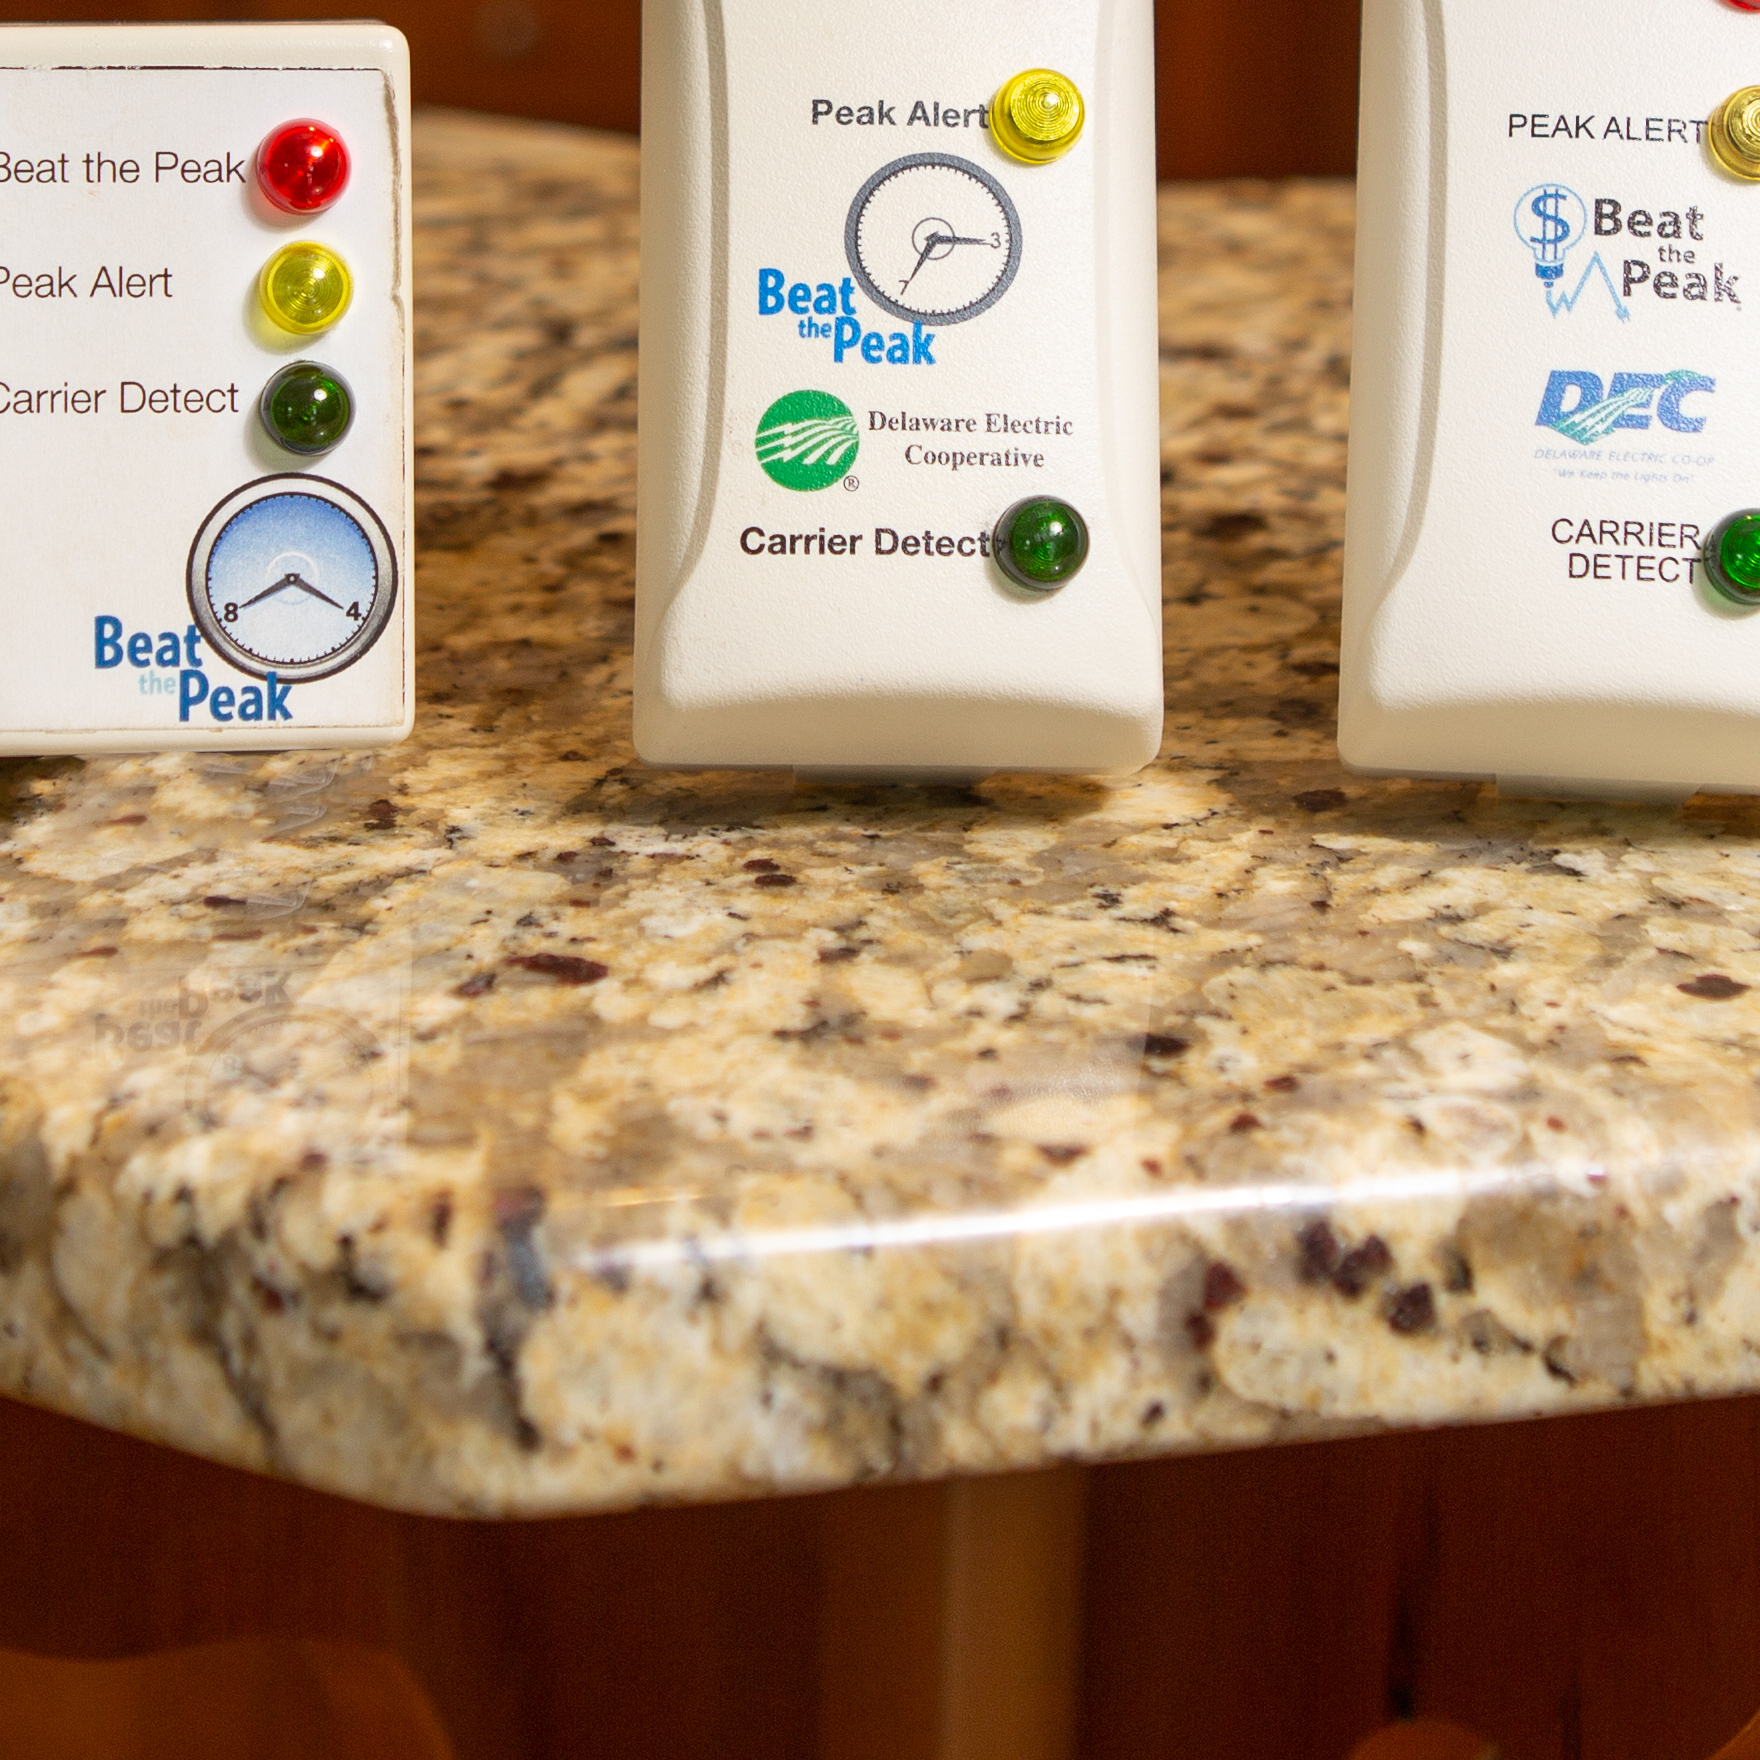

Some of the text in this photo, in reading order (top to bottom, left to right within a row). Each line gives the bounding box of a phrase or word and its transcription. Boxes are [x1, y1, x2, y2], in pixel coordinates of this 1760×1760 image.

[811, 100, 989, 129] Peak Alert
[1507, 113, 1709, 144] PEAK ALERT
[82, 151, 140, 183] the
[154, 151, 246, 183] Peak
[1594, 198, 1704, 241] Beat
[990, 232, 1001, 249] 3
[1658, 244, 1696, 264] the
[90, 266, 173, 298] Alert
[758, 267, 856, 316] Beat
[898, 279, 909, 295] 7
[1622, 259, 1741, 304] Peak
[798, 319, 832, 339] the
[833, 316, 936, 365] Peak
[120, 382, 240, 414] Detect
[1535, 369, 1716, 434] DEC
[868, 411, 1074, 436] Delaware Electric
[905, 445, 1045, 471] Cooperative
[1608, 450, 1665, 464] ELECTRIC
[1579, 469, 1608, 482] Keep
[1612, 470, 1630, 480] the
[1634, 471, 1667, 484] Lights
[740, 526, 990, 558] Carrier Detect
[1551, 518, 1701, 550] CARRIER
[1569, 552, 1702, 584] DETECT
[224, 602, 238, 623] 8
[345, 601, 361, 622] 4
[94, 615, 203, 669] Beat
[139, 670, 176, 695] the
[179, 669, 293, 723] Peak
